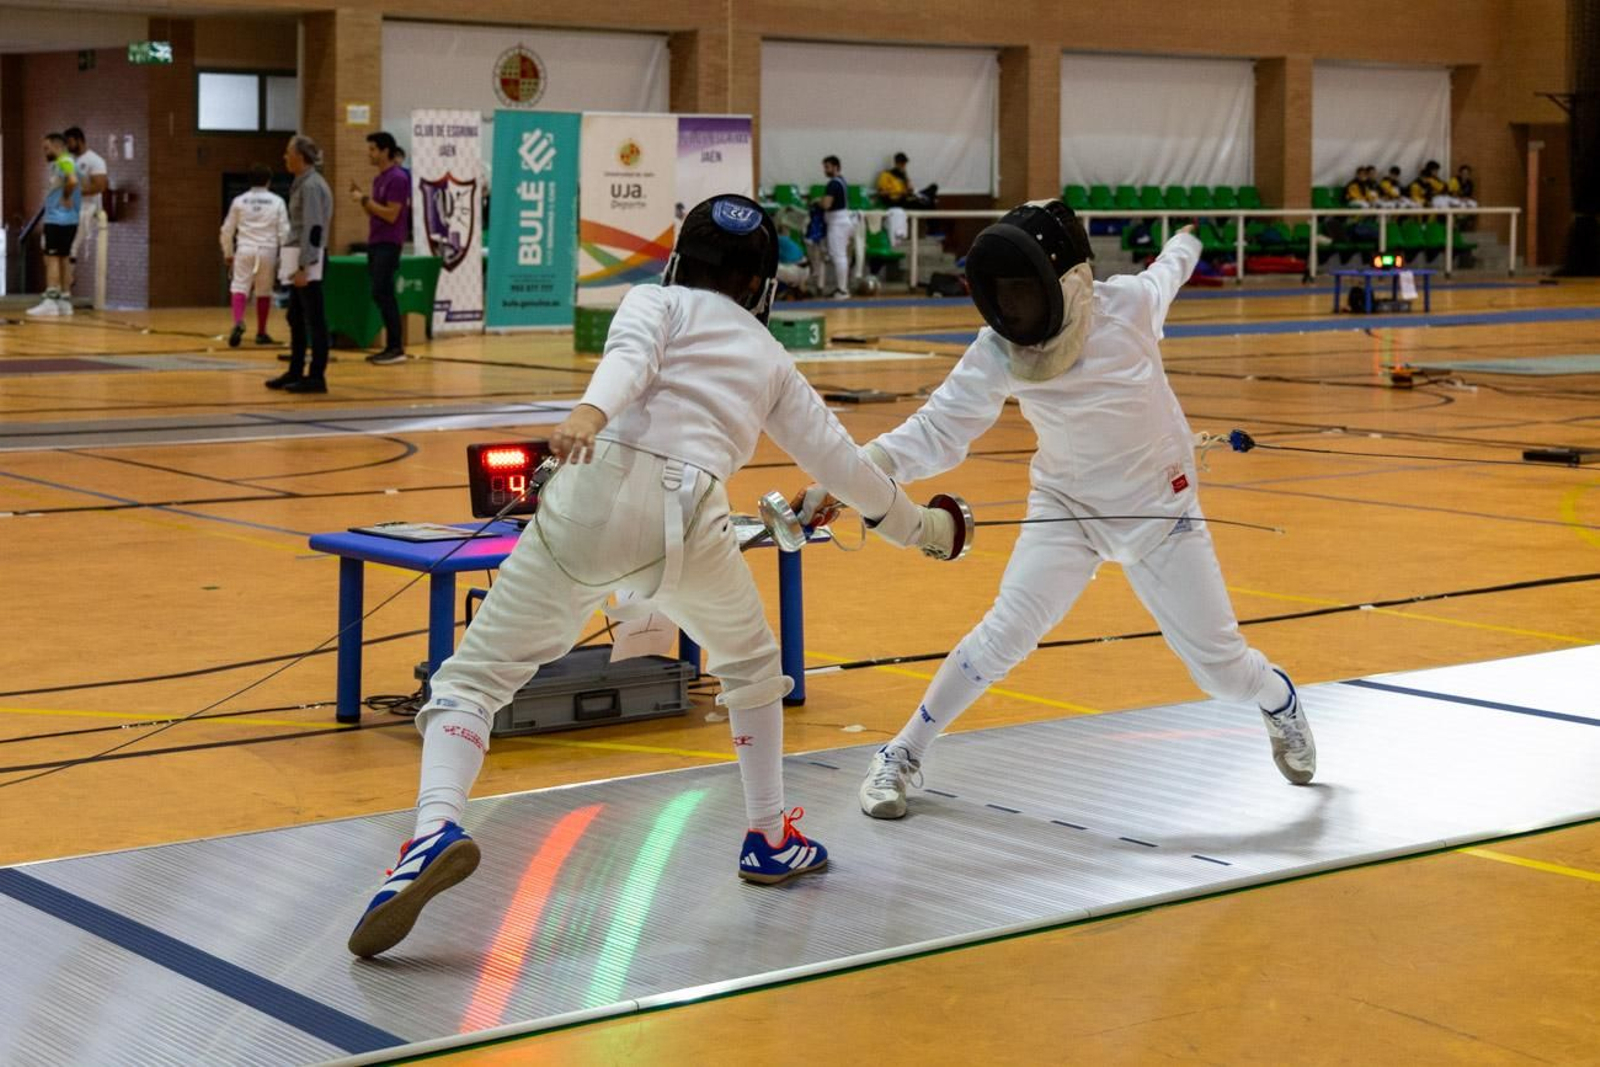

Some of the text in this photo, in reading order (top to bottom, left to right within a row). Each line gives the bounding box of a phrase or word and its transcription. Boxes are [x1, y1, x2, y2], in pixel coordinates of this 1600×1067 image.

[414, 124, 479, 138] CLUB DE ESGRIMA
[810, 323, 820, 345] 3
[509, 475, 526, 502] 4
